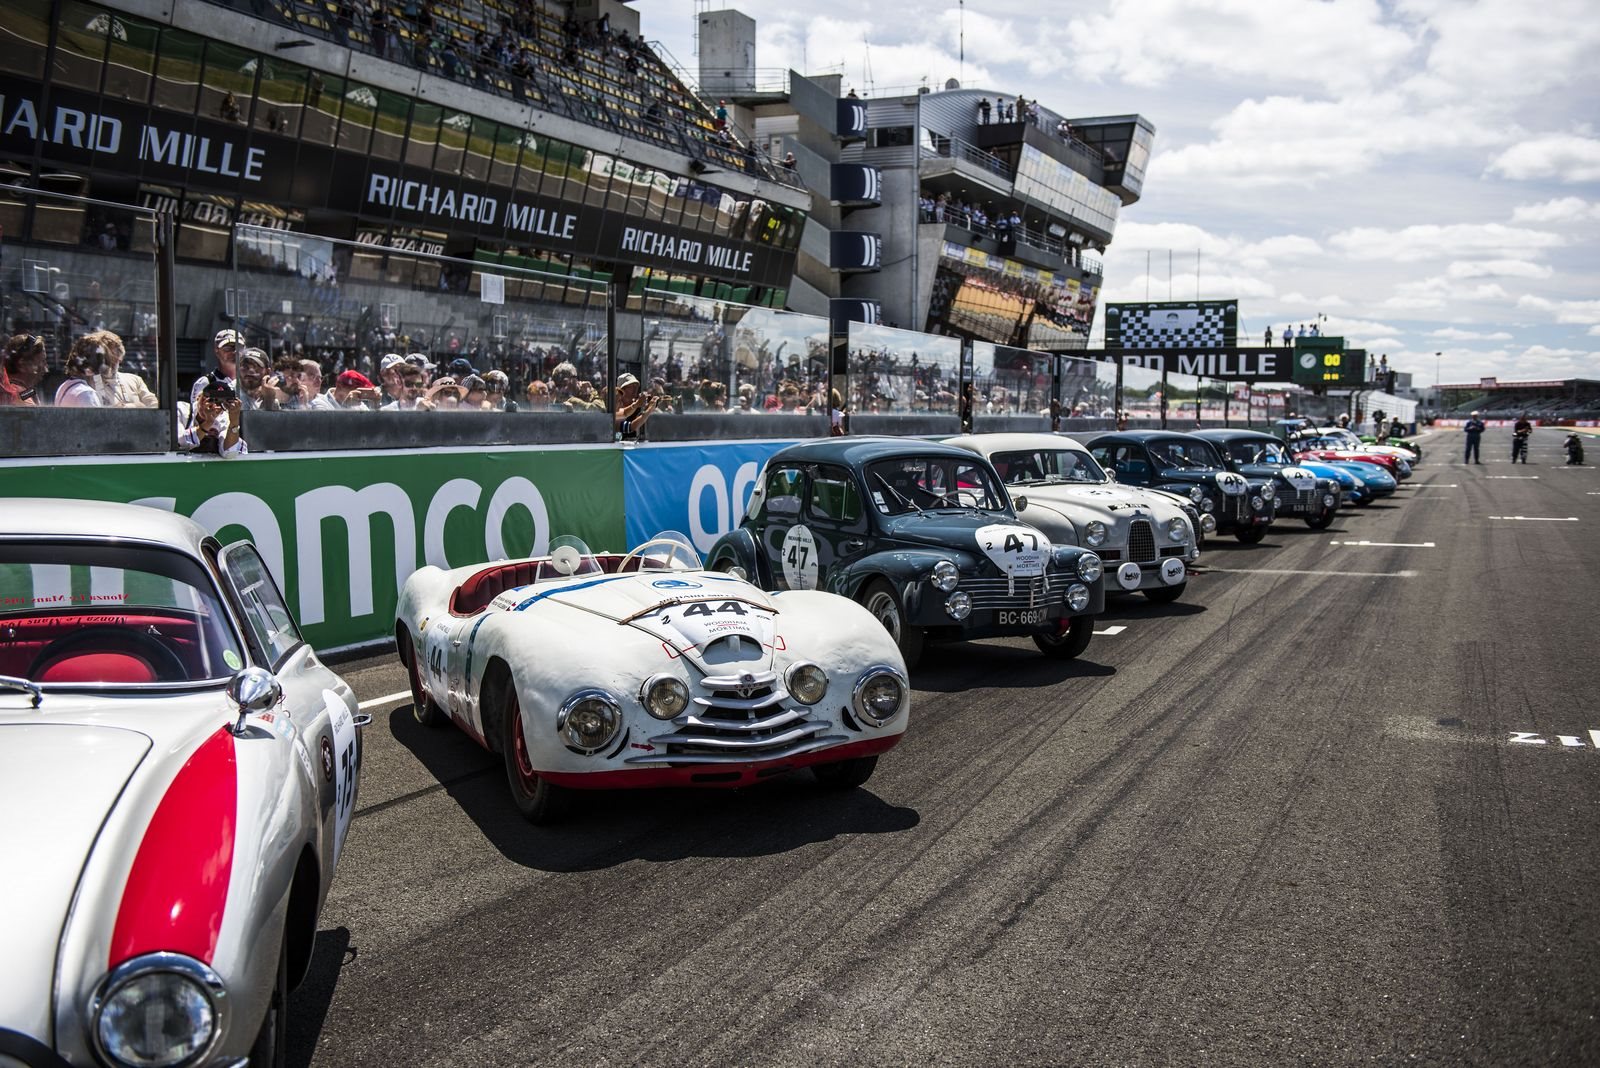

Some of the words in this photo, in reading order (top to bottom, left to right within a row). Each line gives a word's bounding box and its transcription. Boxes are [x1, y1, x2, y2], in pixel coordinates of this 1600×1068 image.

[139, 124, 266, 183] MILLE
[368, 173, 497, 226] RICHARD
[504, 202, 577, 240] MILLE
[621, 226, 702, 263] RICHARD
[705, 244, 753, 272] MILLE
[1178, 352, 1277, 376] MILLE
[787, 545, 809, 570] 47
[985, 541, 994, 551] 2
[1003, 533, 1039, 554] 47
[661, 615, 671, 625] 2
[683, 601, 749, 618] 44
[430, 645, 442, 683] 44
